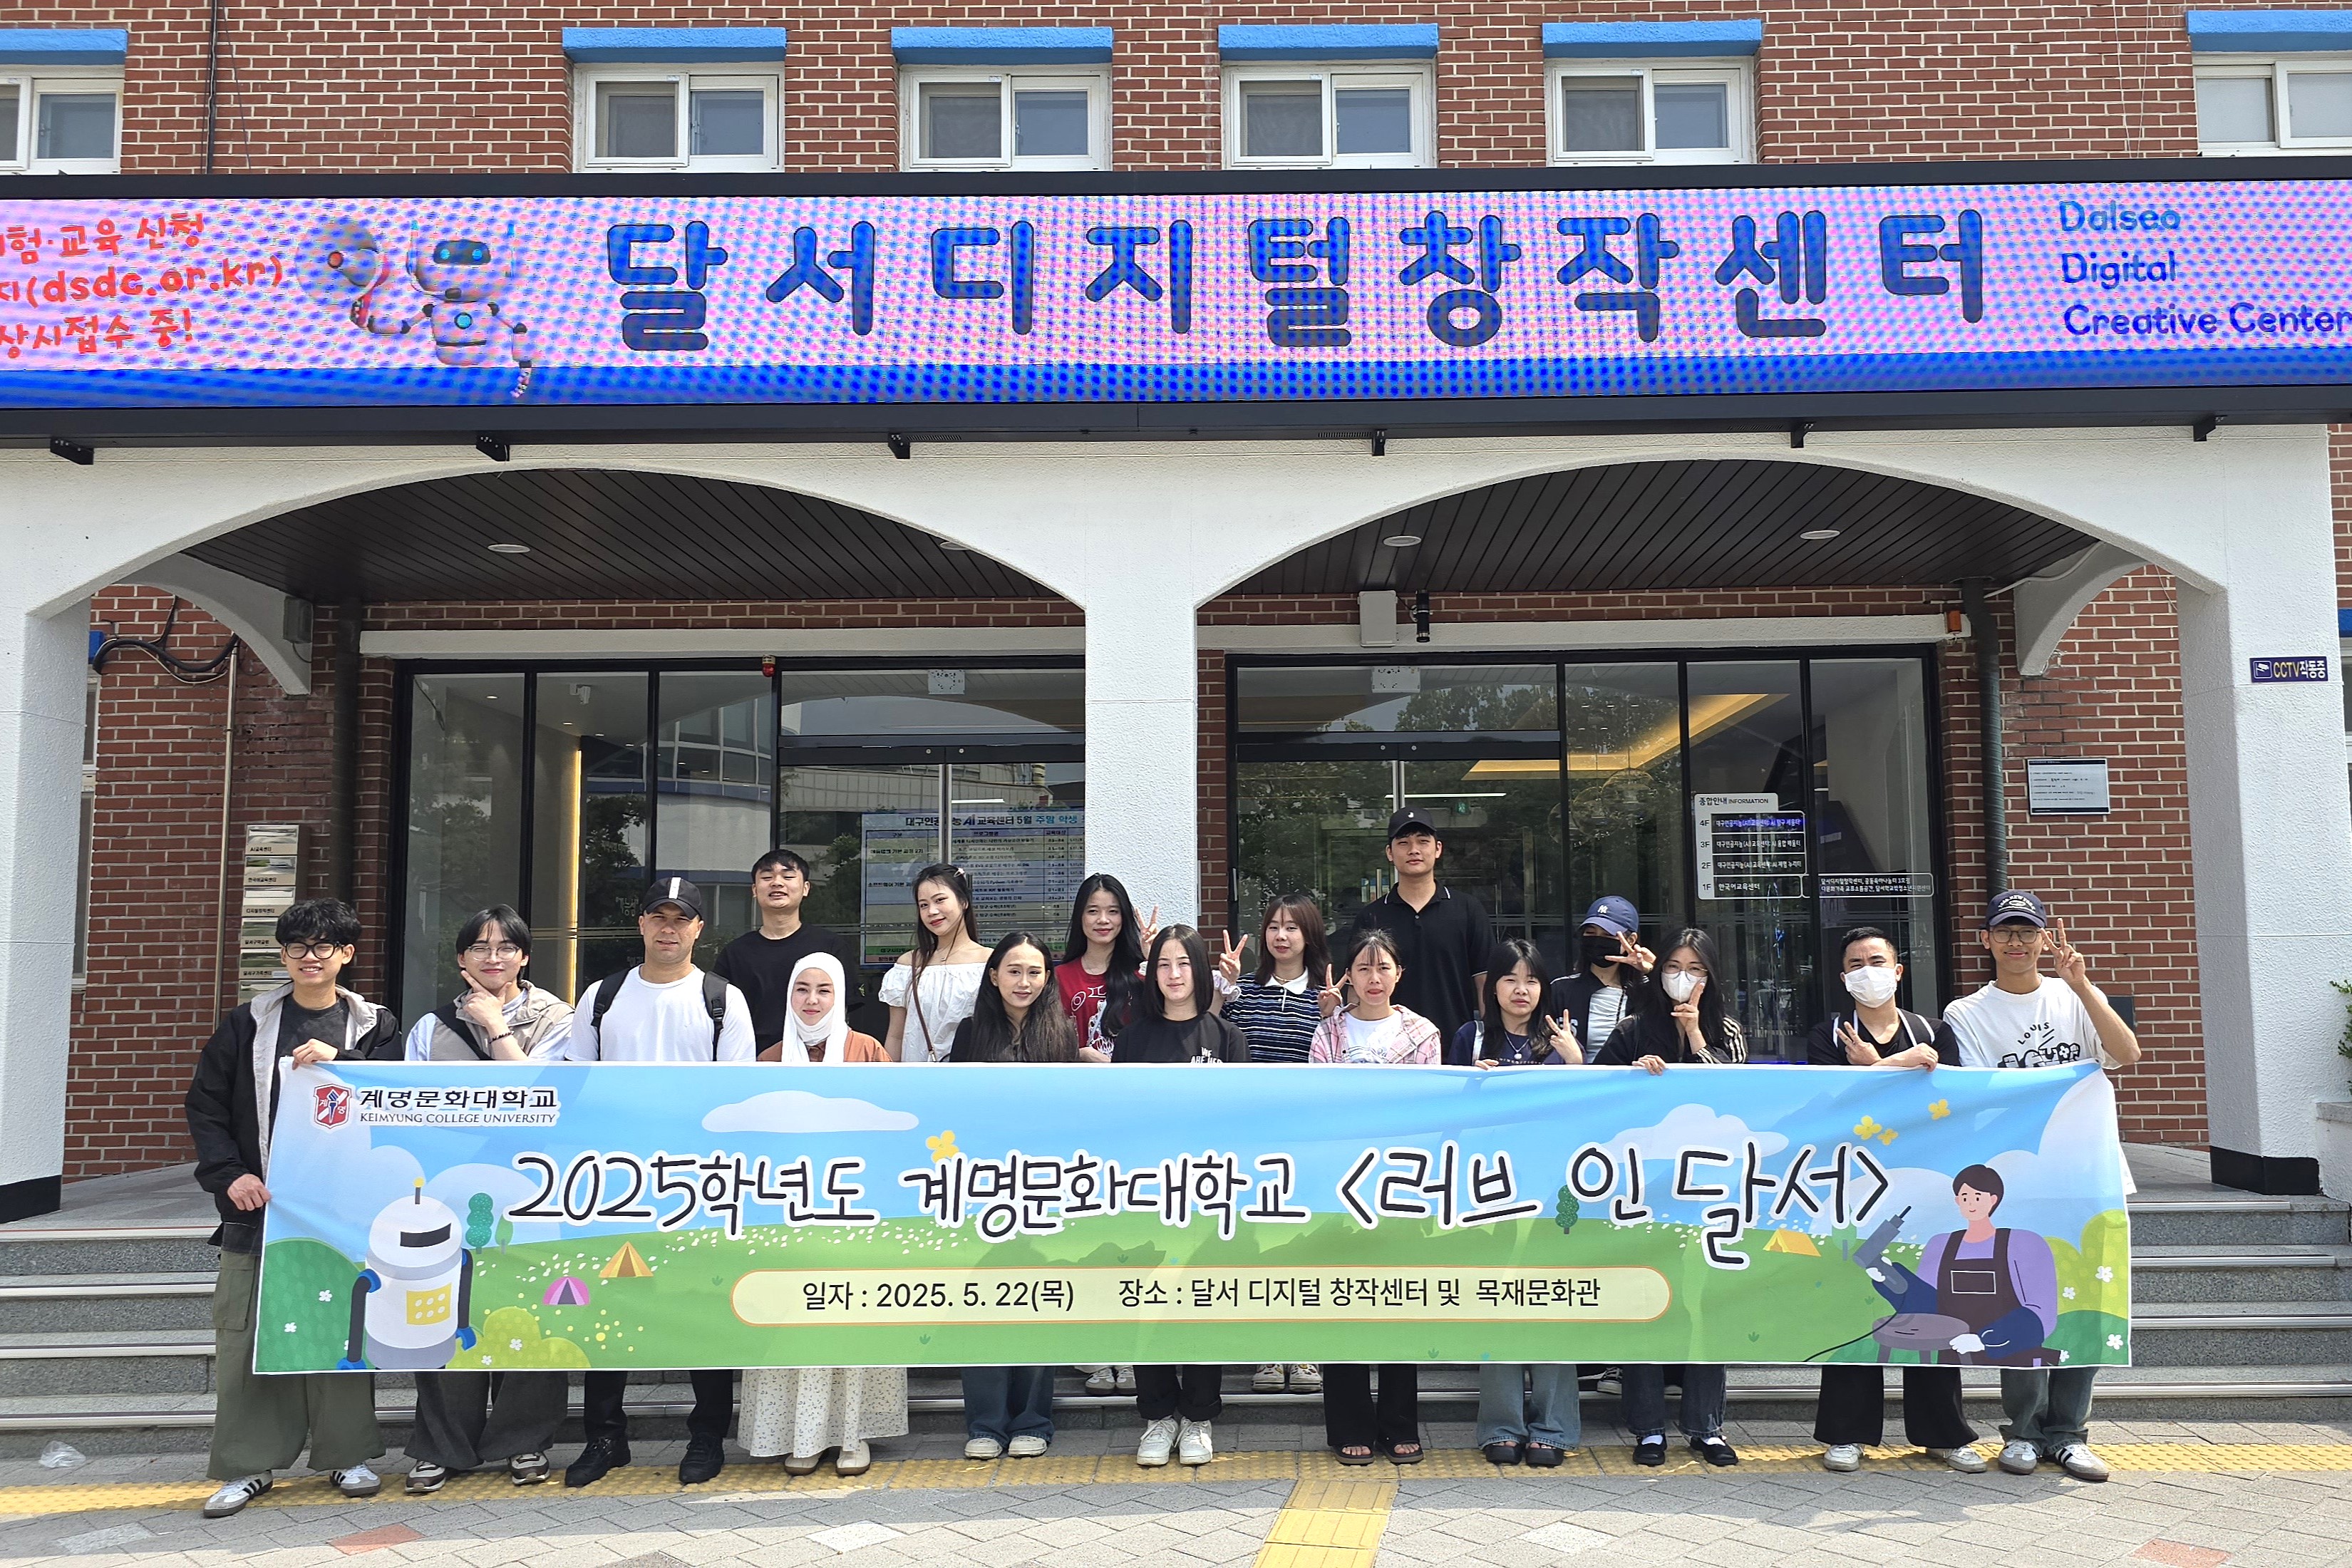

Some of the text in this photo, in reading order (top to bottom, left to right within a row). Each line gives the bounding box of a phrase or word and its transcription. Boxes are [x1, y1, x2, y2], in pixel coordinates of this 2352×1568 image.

[136, 212, 205, 249] 신청
[2058, 200, 2182, 232] Dalseo
[607, 210, 1984, 351] 달서디지털창작센터
[2061, 250, 2177, 289] Digital
[149, 307, 194, 348] 중!
[2063, 302, 2352, 335] Creative Center
[1698, 797, 1728, 806] 종합안내
[977, 815, 1014, 826] 교육센터
[1016, 815, 1033, 825] 5월
[1036, 815, 1055, 825] 주말
[1058, 815, 1078, 825] 학생
[1718, 882, 1760, 891] 한국어교육센터
[2017, 1021, 2050, 1045] LOUIS
[359, 1088, 558, 1110] 계명문화대학교
[360, 1113, 556, 1123] KEIMYUNG COLLEGE UNIVERSITY
[507, 1141, 1888, 1265] 2025학년도 계명문화대학교 <러브 인 달서>
[803, 1281, 853, 1311] 일자
[877, 1282, 953, 1308] 2025.
[963, 1282, 986, 1307] 5.
[995, 1280, 1074, 1312] 22(목)
[1118, 1279, 1167, 1306] 장소
[1191, 1279, 1238, 1306] 달서
[1249, 1279, 1321, 1306] 디지털
[1329, 1278, 1428, 1306] 창작센터
[1438, 1279, 1460, 1306] 및
[1475, 1278, 1601, 1307] 목재문화관
